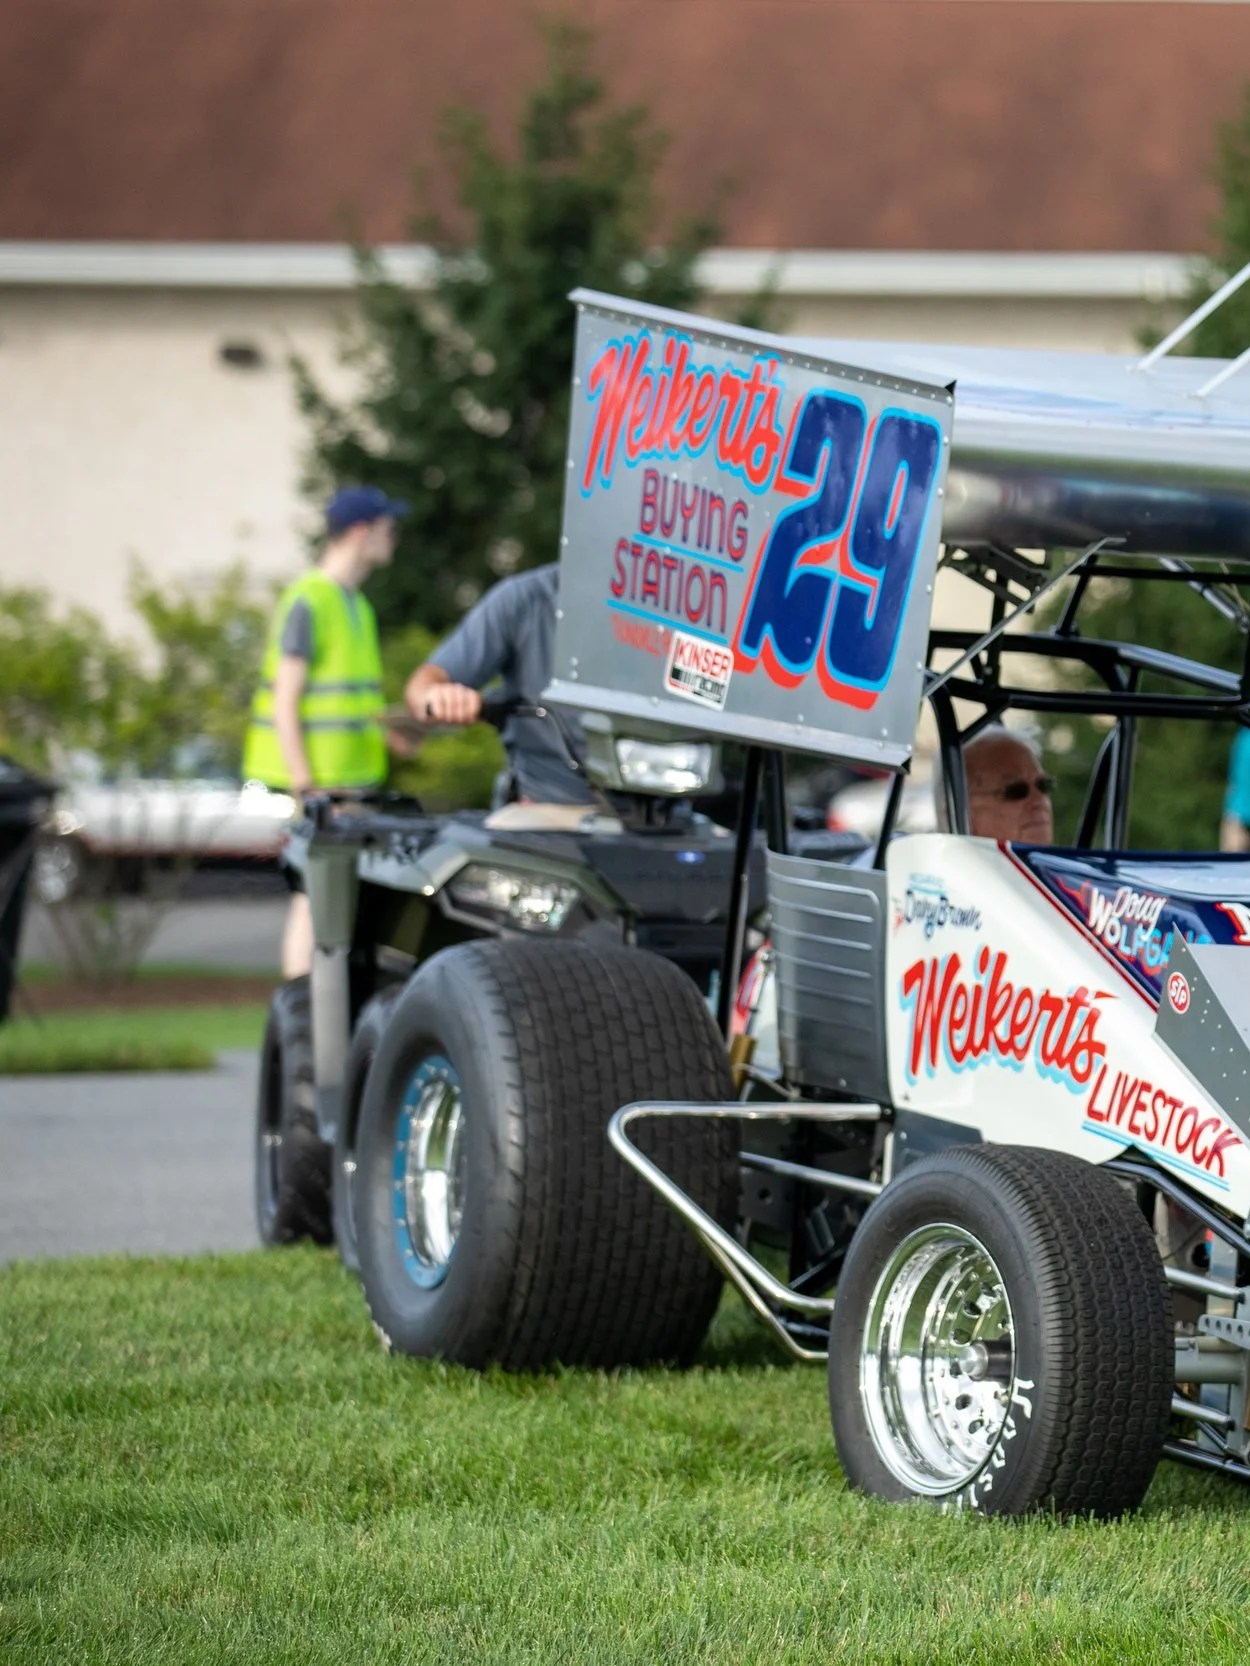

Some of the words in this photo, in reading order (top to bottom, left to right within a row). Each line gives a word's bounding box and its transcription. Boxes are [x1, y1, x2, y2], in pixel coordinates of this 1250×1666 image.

[582, 330, 786, 497] Weikert's
[639, 468, 749, 562] BUYING
[733, 387, 943, 711] 29
[610, 538, 728, 634] STATION
[675, 638, 730, 681] KINSER
[1088, 886, 1214, 972] WOLFGA
[1111, 886, 1168, 941] Doug
[902, 946, 1119, 1090] Weikert's
[1168, 977, 1189, 1009] STP
[1085, 1069, 1244, 1178] LIVESTOCK
